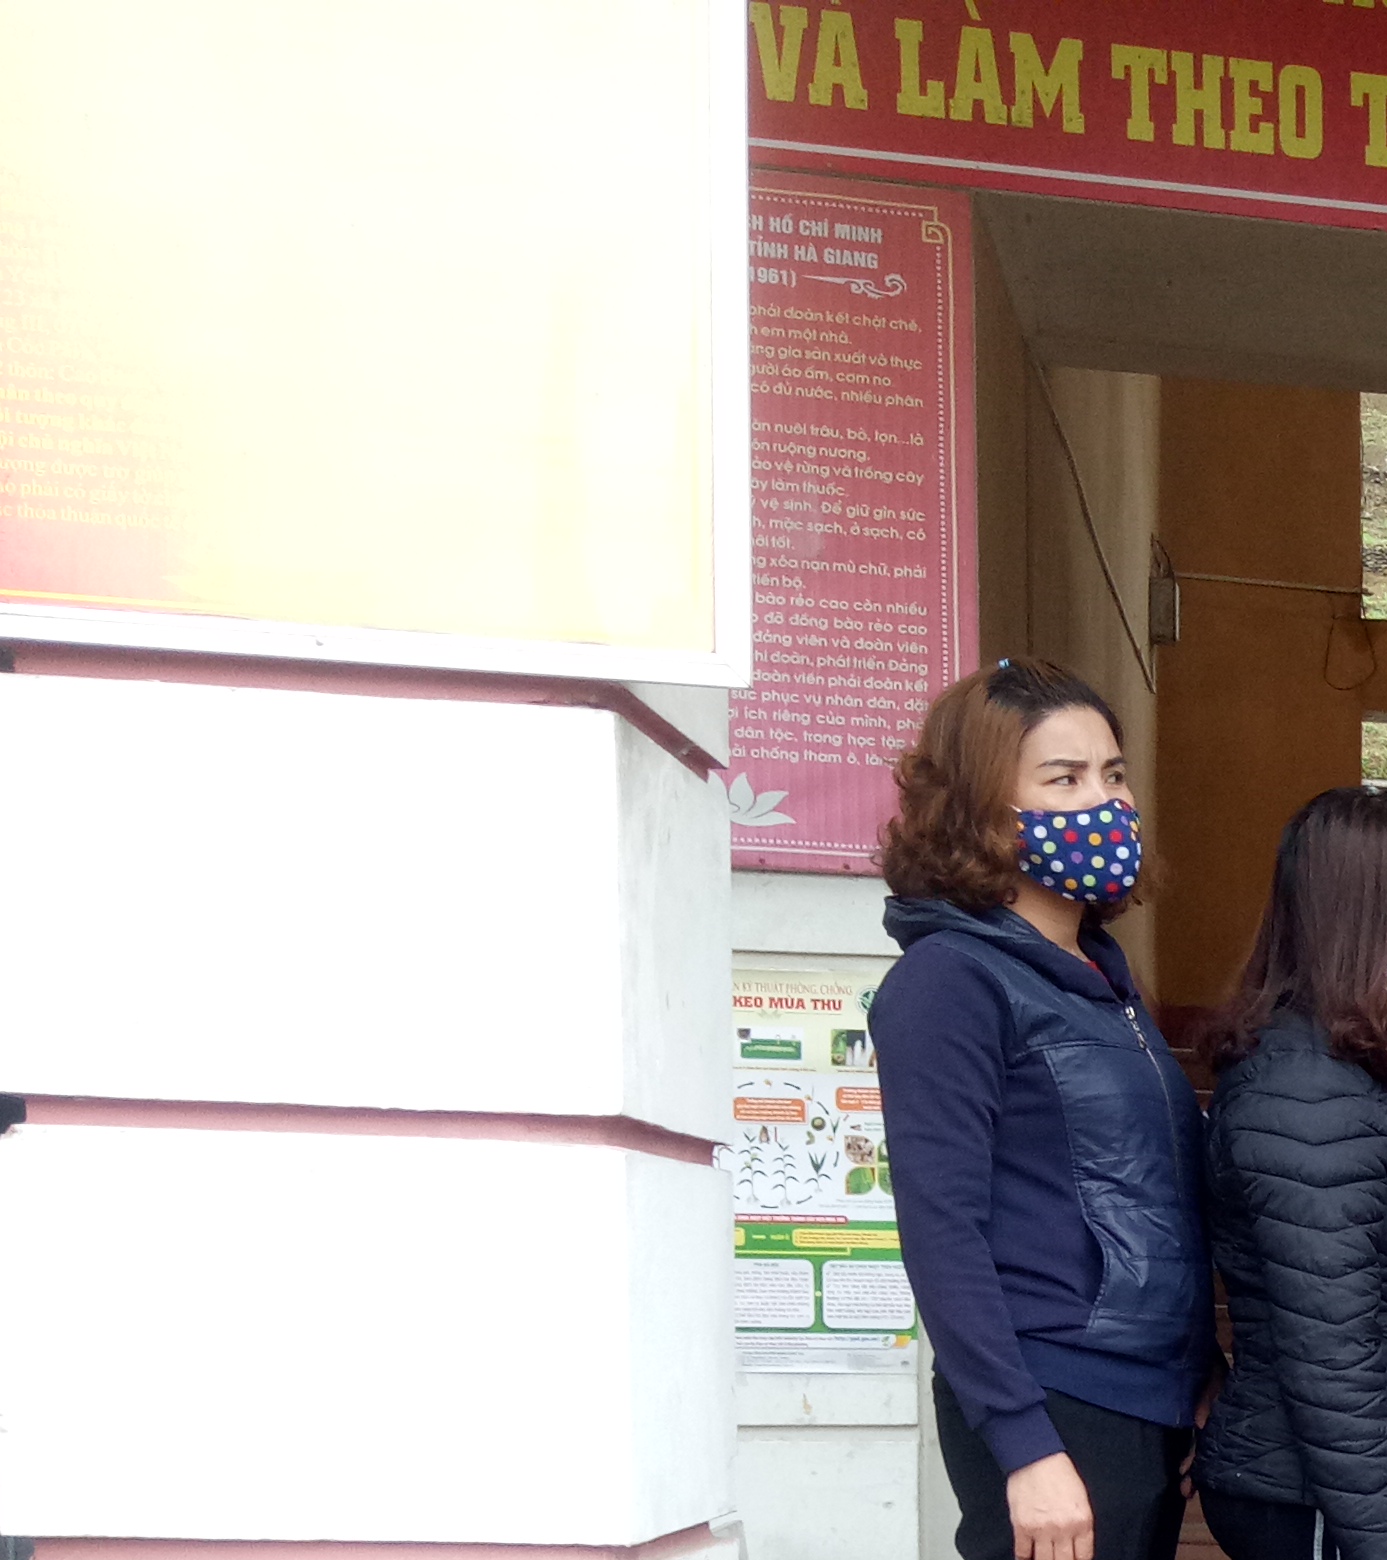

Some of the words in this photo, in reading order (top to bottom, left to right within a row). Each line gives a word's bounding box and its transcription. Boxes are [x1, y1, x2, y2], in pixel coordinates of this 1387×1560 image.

[895, 0, 1084, 135] LÀM
[1111, 43, 1323, 159] THEO
[835, 223, 882, 244] MINH
[794, 243, 817, 262] HÀ
[824, 248, 878, 269] GIANG
[769, 995, 806, 1010] MÙA
[812, 999, 842, 1011] THU
